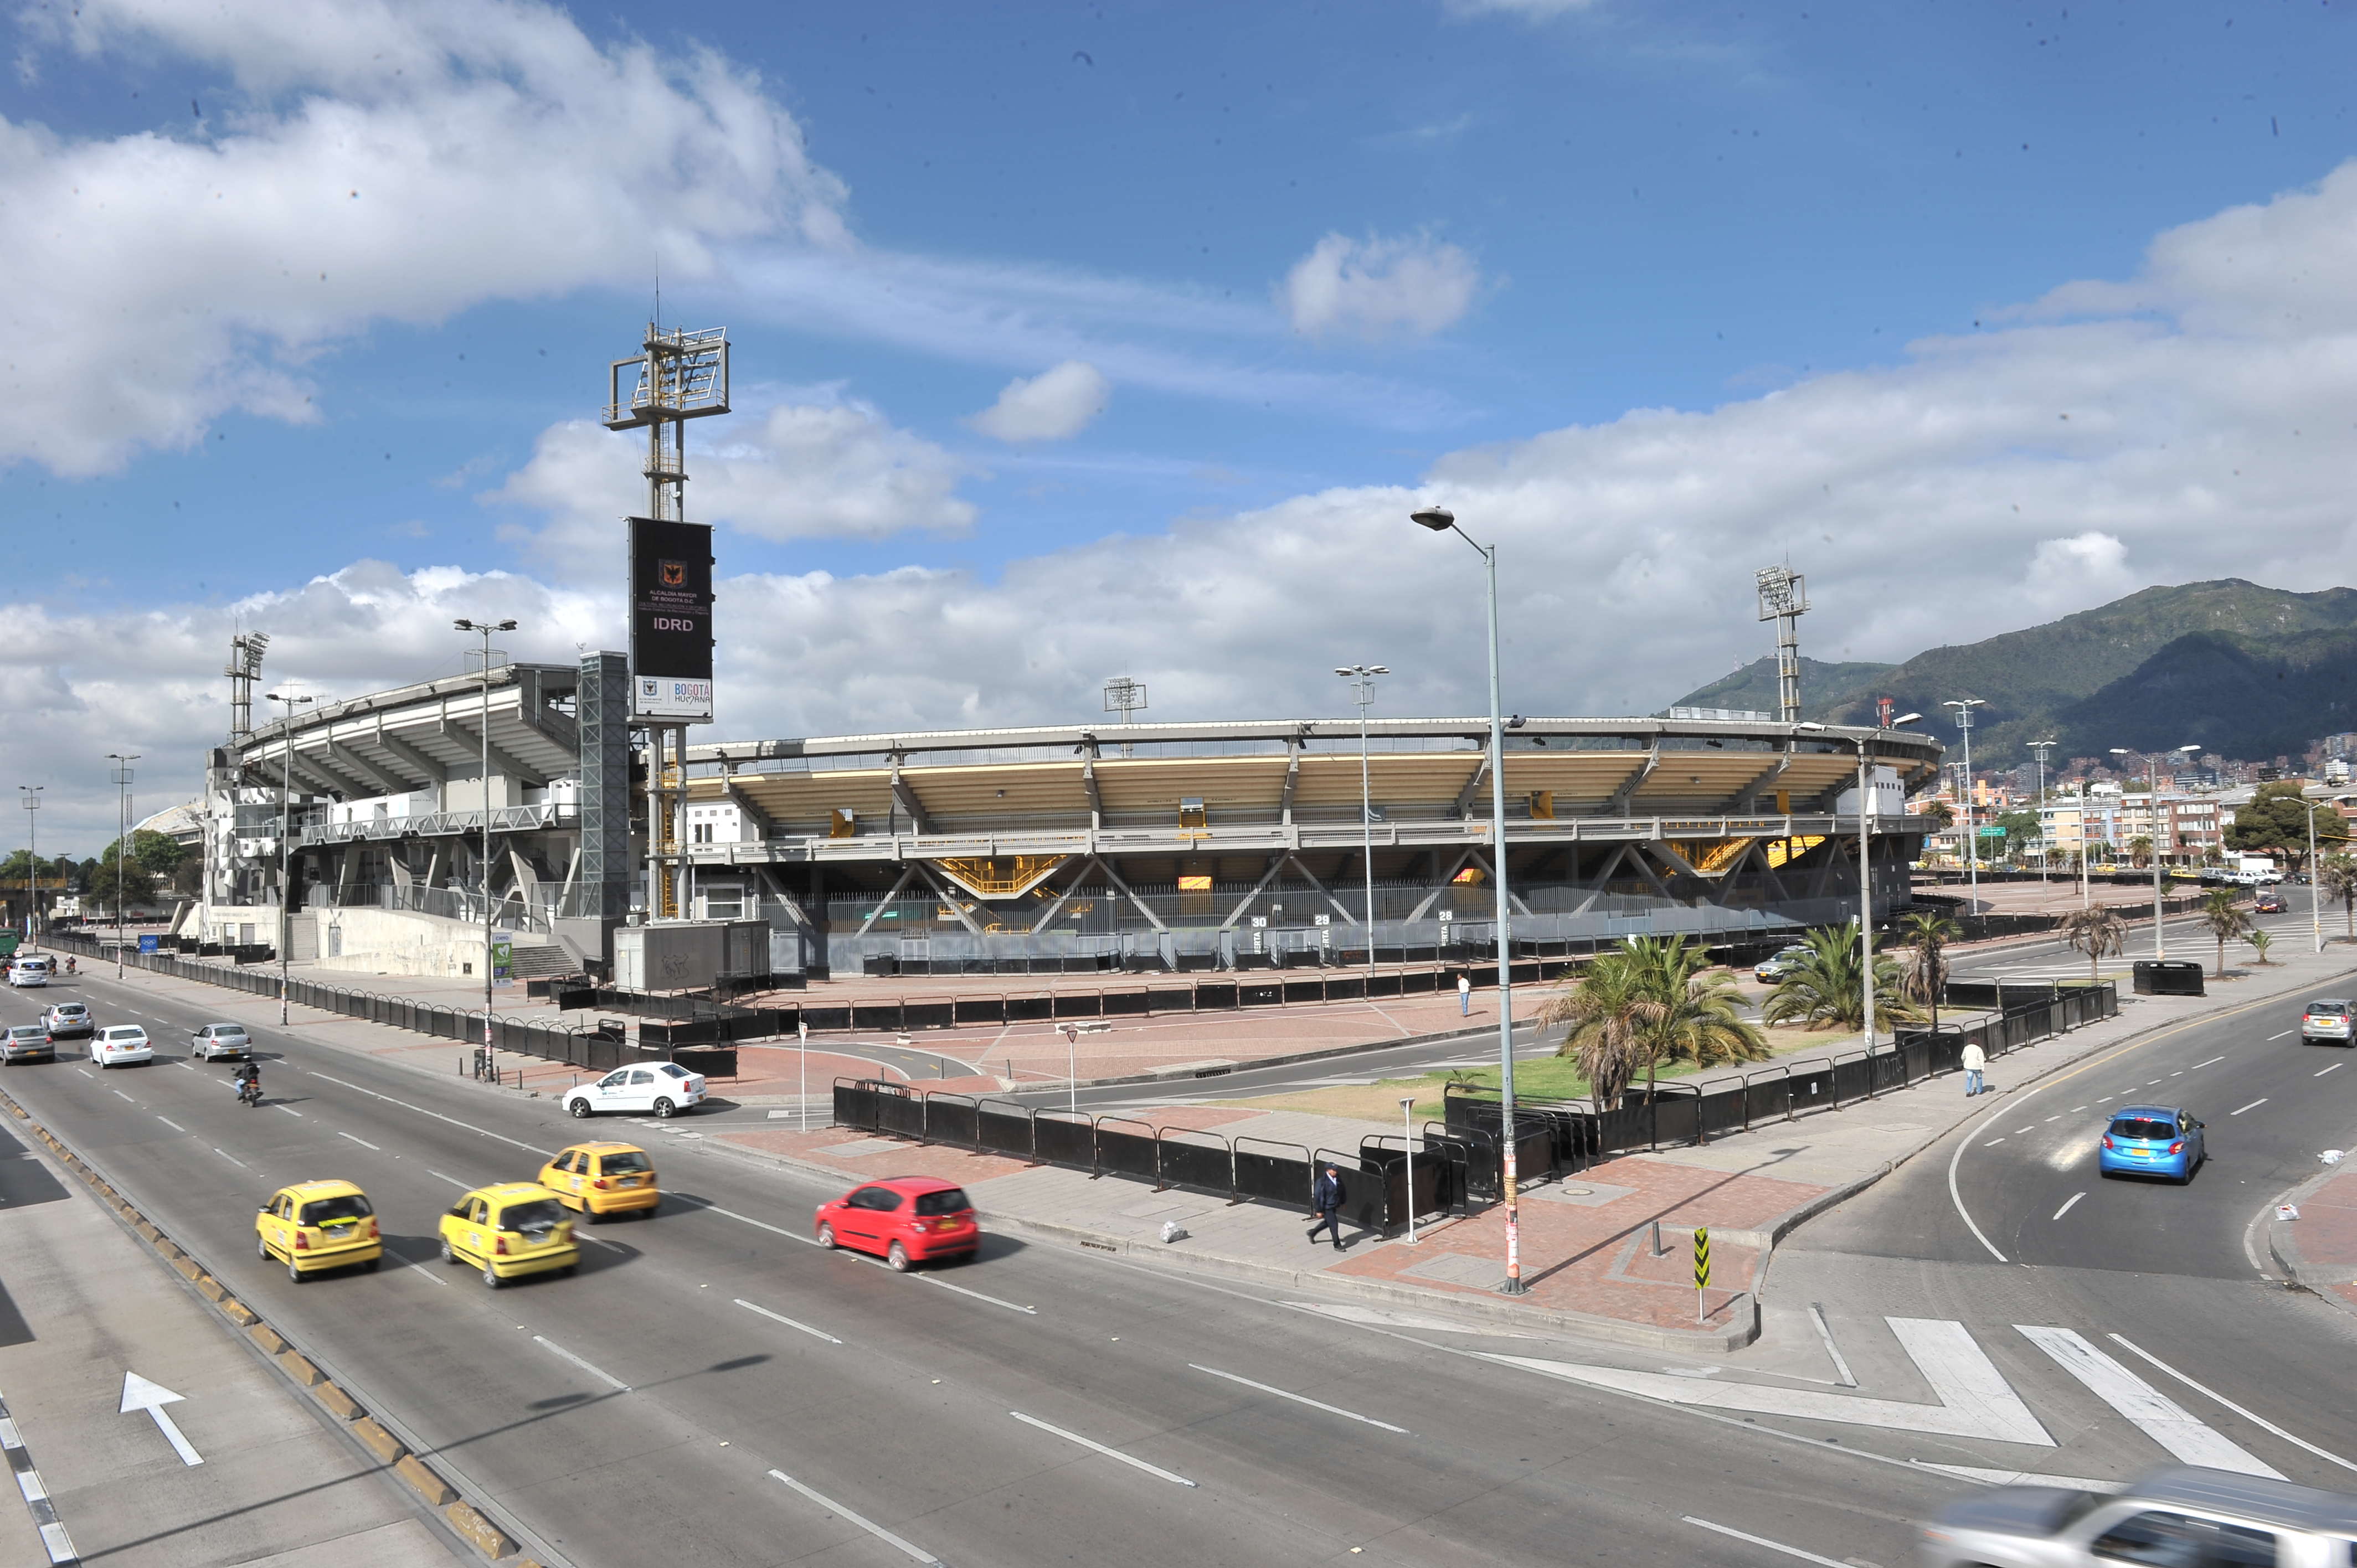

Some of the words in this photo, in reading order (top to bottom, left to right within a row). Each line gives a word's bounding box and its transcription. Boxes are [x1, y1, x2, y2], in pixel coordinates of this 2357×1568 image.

[653, 617, 693, 632] IDRD
[675, 683, 709, 695] BOGOTÁ
[1315, 915, 1329, 925] 29
[1439, 911, 1453, 921] 28
[1252, 917, 1267, 927] 30
[1876, 1058, 1890, 1085] NO
